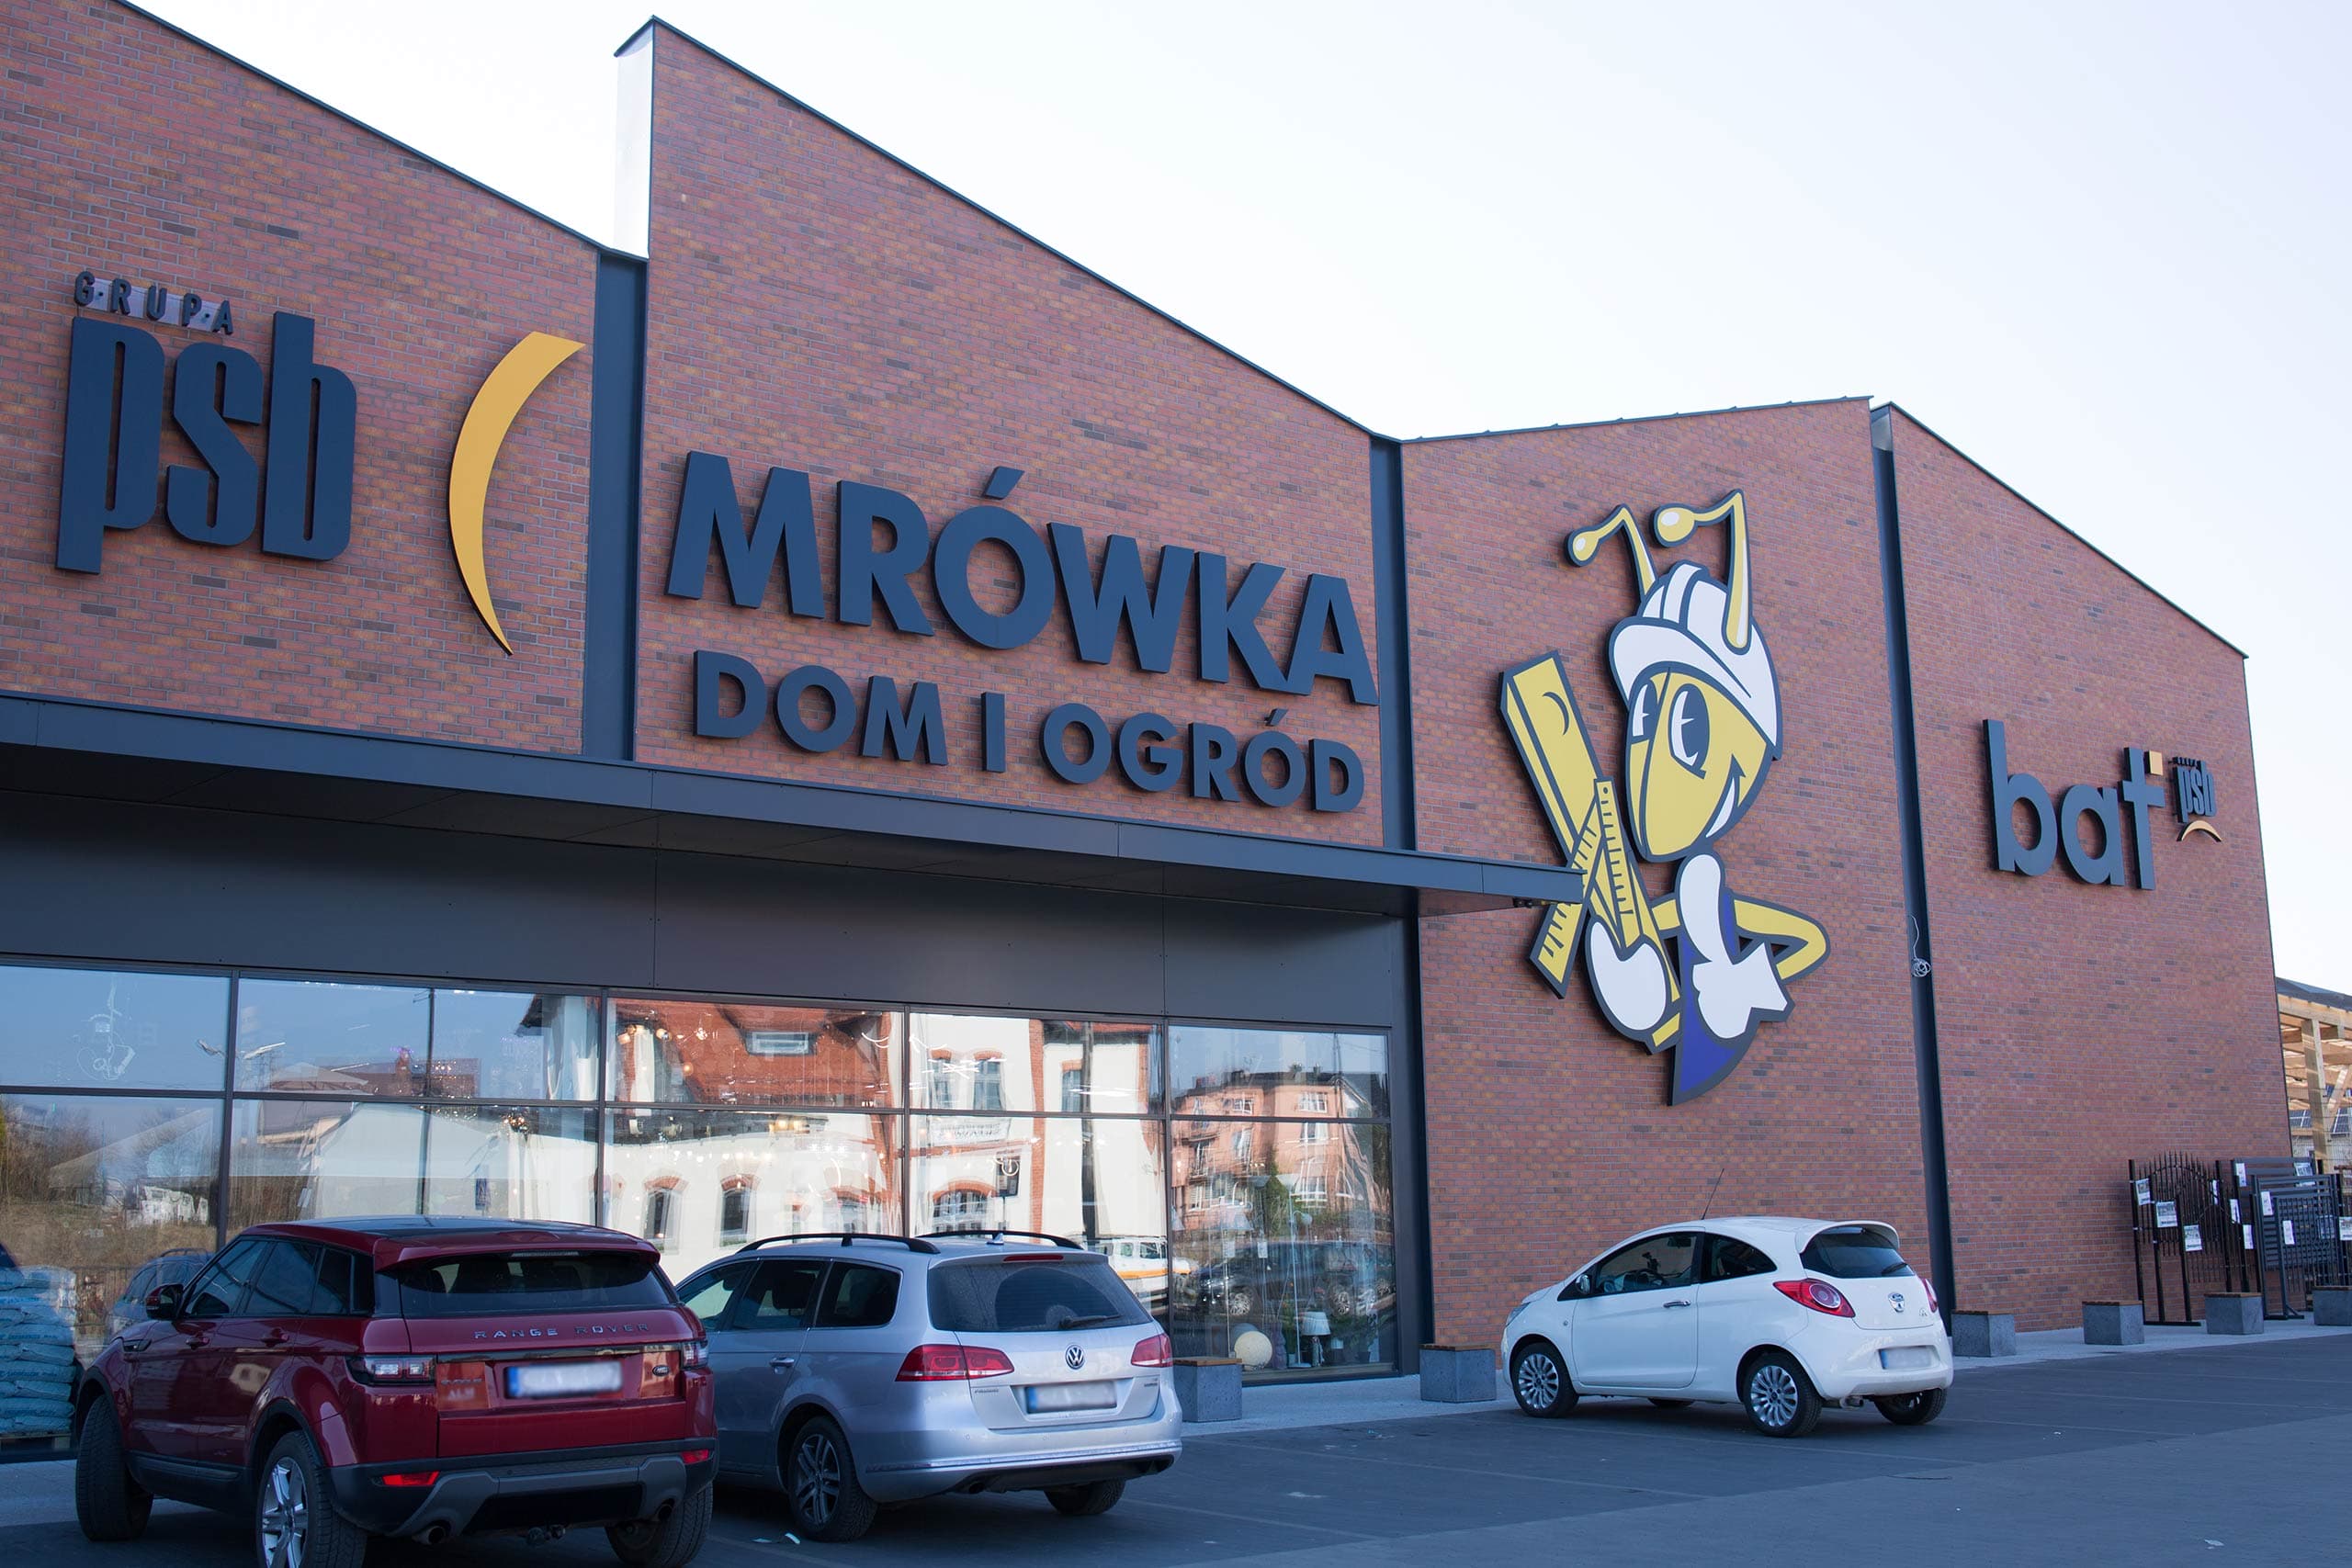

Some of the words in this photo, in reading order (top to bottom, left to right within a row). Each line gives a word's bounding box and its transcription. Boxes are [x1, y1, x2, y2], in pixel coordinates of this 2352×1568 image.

[74, 271, 233, 334] GRUPA
[55, 310, 357, 574] psb
[665, 450, 1380, 705] MRÓWKA
[694, 649, 948, 766] DOM
[980, 692, 1006, 773] I
[1040, 708, 1365, 813] OGRÓD
[1983, 718, 2165, 890] bat
[2173, 760, 2217, 823] psb
[474, 1327, 558, 1338] RANGE
[576, 1323, 649, 1335] ROVER
